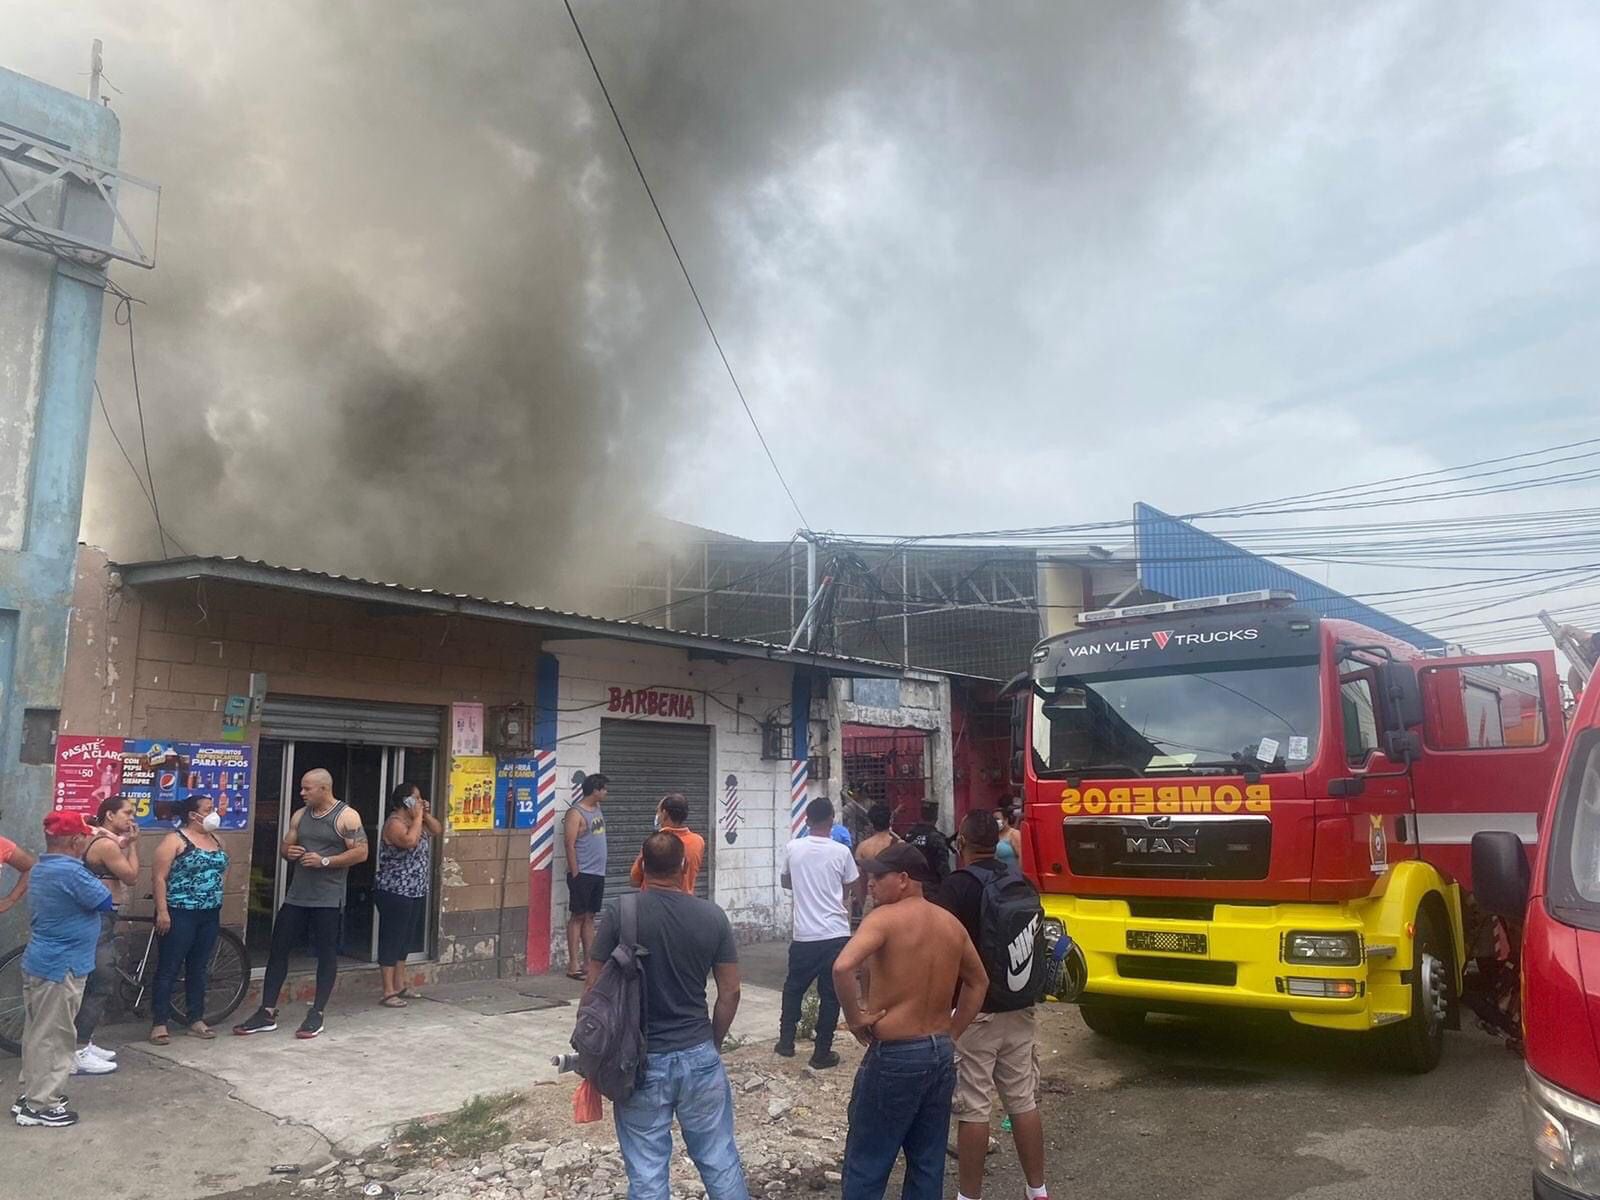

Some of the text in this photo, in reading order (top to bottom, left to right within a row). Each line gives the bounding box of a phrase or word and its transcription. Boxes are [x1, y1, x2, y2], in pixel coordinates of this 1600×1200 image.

[1069, 629, 1259, 657] VAN VLIET TRUCKS
[607, 687, 694, 718] BARBERIA
[83, 751, 91, 760] A
[1126, 837, 1197, 854] MAN
[1007, 912, 1043, 972] NIKE
